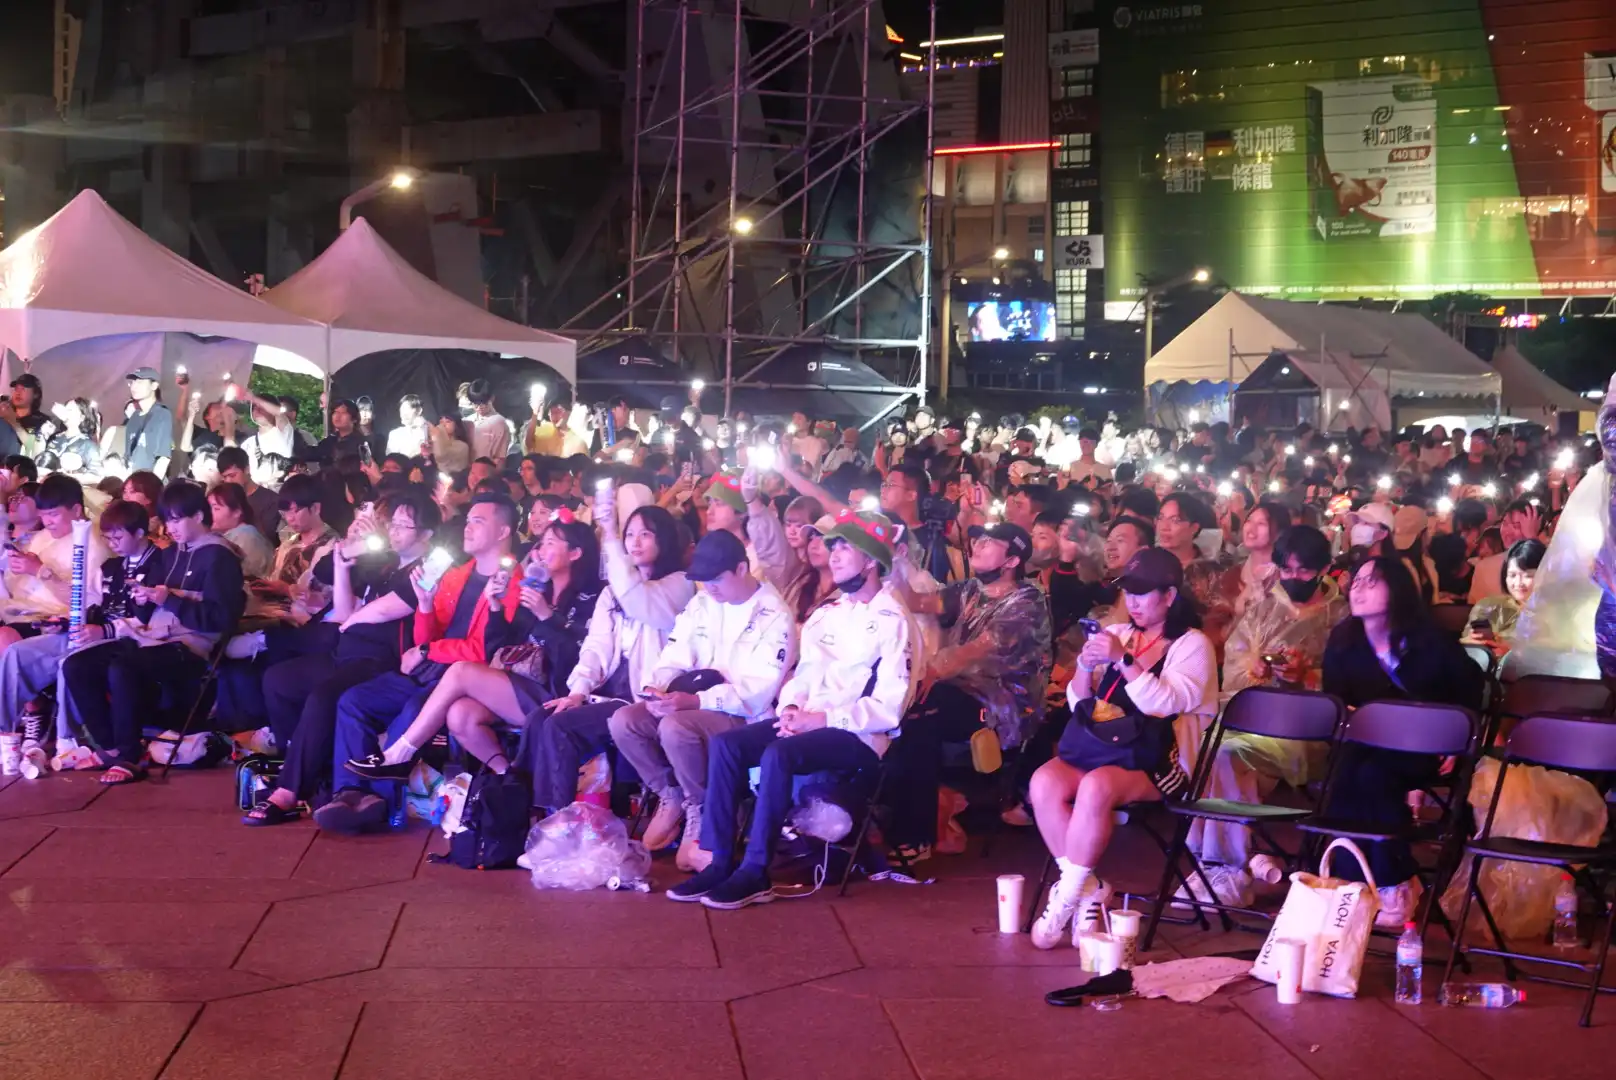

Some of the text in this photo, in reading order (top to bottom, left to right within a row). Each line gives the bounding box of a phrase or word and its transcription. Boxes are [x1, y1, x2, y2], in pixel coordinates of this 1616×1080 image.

[1233, 125, 1296, 156] 利加隆
[1212, 163, 1273, 191] 一條龍
[1066, 257, 1092, 266] KURA
[72, 544, 85, 580] LEGACY
[1333, 892, 1355, 929] HOYA
[1319, 939, 1340, 978] HOYA
